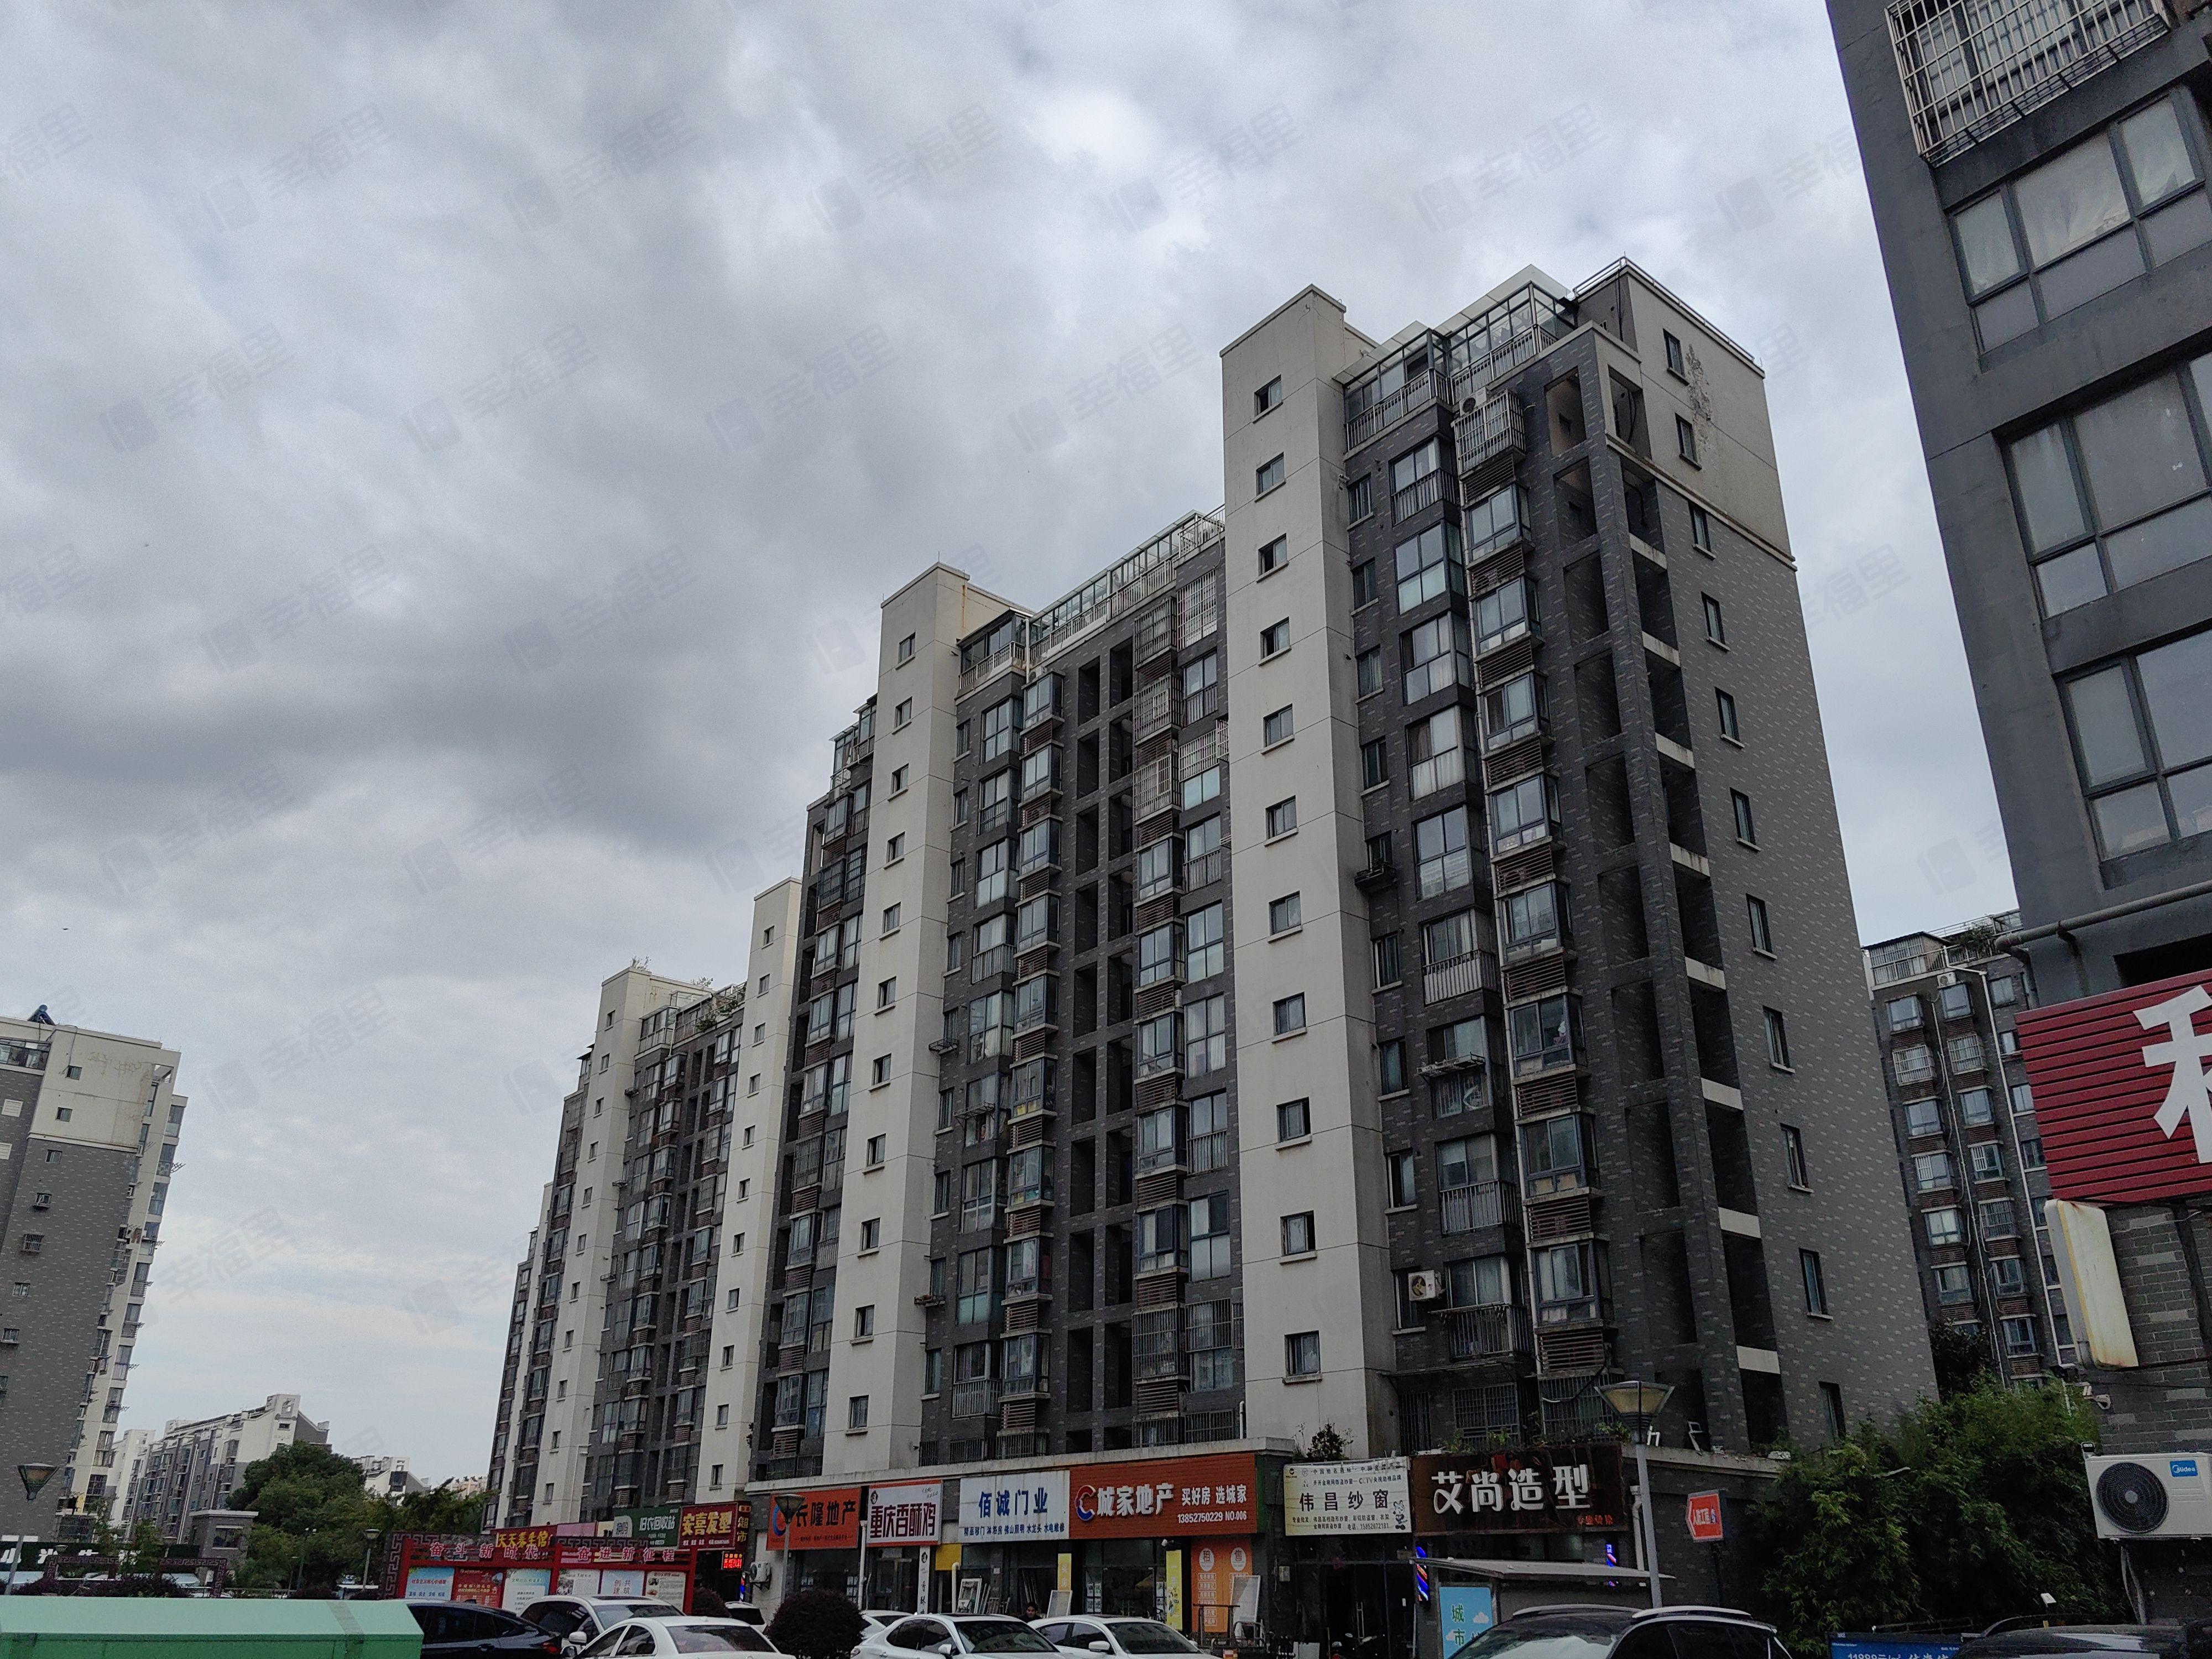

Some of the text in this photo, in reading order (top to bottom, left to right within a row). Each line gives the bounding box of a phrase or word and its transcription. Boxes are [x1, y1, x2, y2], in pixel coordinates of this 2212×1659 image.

[2172, 1465, 2196, 1473] Midea
[1182, 1484, 1247, 1506] 买好房 选城家
[1431, 1464, 1591, 1514] 艾尚造型
[979, 1487, 1048, 1518] 佰诚门业
[1097, 1483, 1175, 1516] 城家地产
[1300, 1489, 1389, 1511] 伟昌纱窗
[639, 1515, 675, 1531] 旧衣回收站
[681, 1511, 732, 1536] 安喜发型
[870, 1503, 936, 1538] 重庆香酥鸡
[1177, 1511, 1223, 1524] 13852750229
[497, 1531, 549, 1548] 天天养生馆
[1004, 1524, 1025, 1535] 佛山照明
[430, 1542, 539, 1560] 奋斗新时代
[577, 1546, 675, 1562] 奋进新征程
